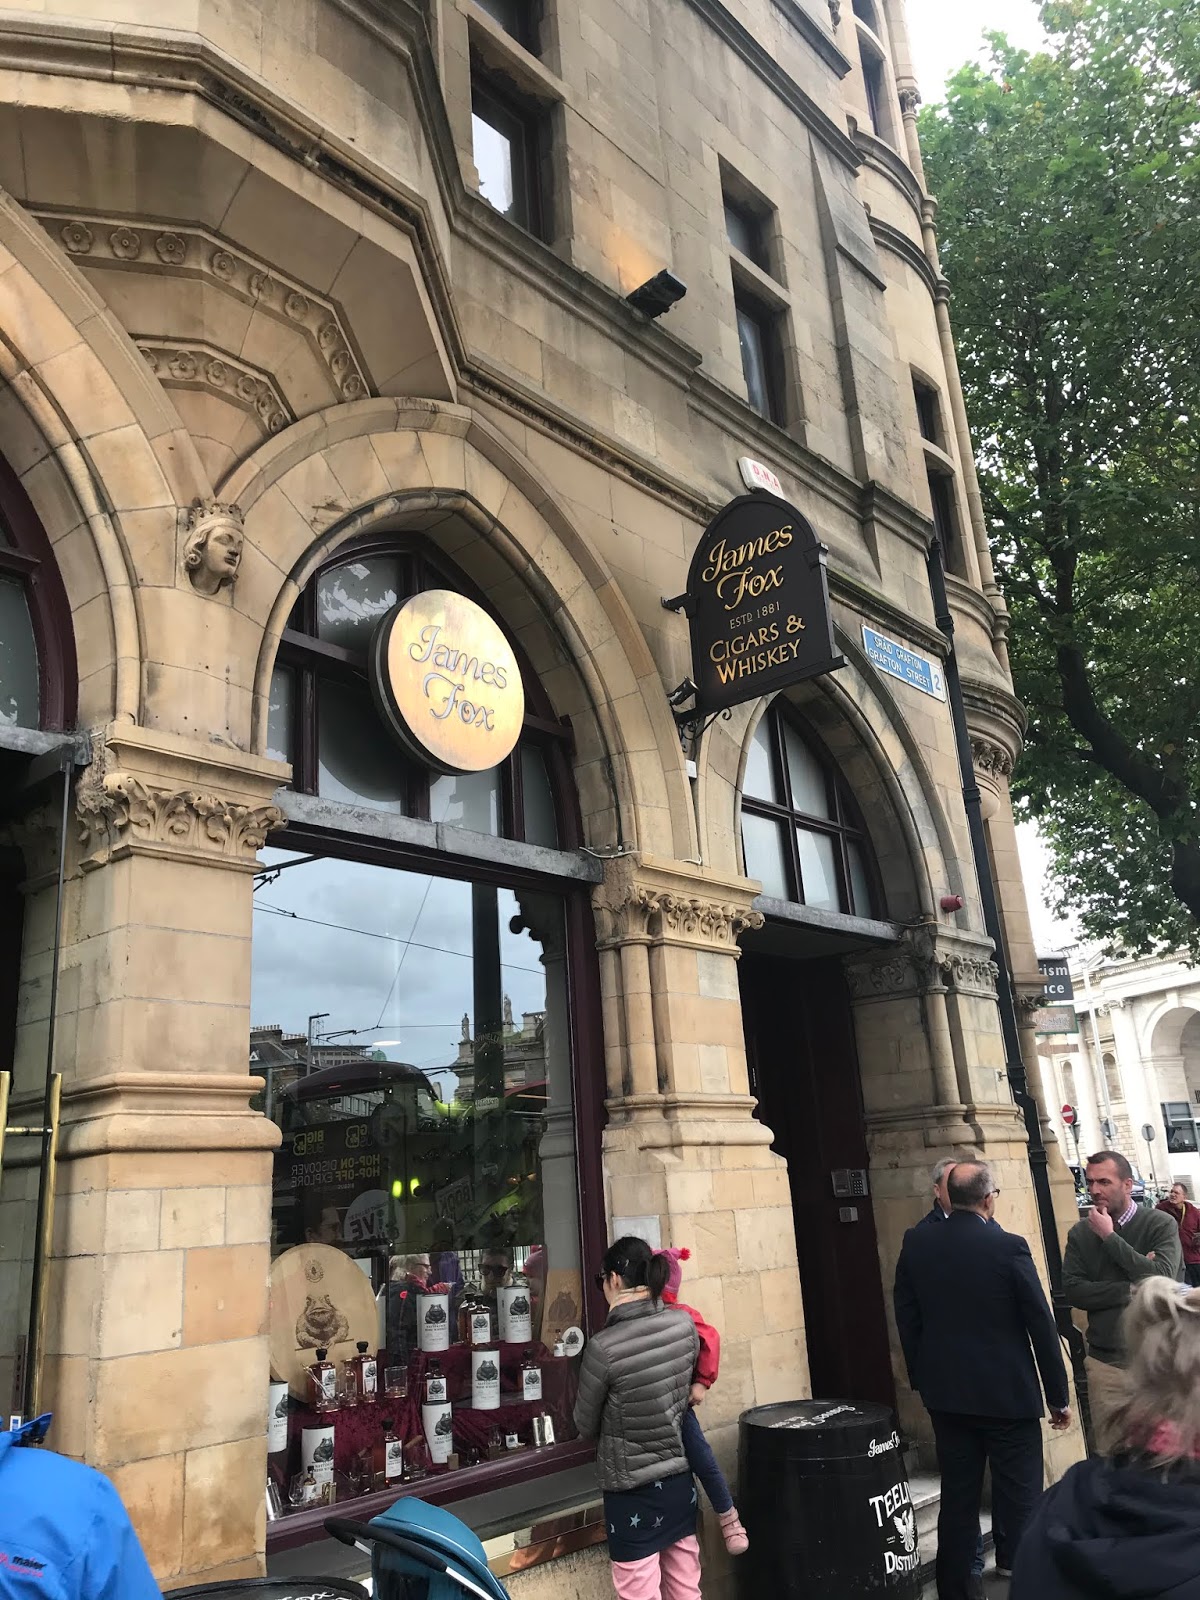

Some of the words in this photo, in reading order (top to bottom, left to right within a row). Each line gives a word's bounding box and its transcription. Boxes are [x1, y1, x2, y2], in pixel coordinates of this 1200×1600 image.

[702, 525, 793, 582] James
[717, 566, 784, 610] Fox
[709, 622, 779, 663] CIGARS
[786, 614, 806, 634] &
[729, 612, 753, 630] ESTD
[757, 601, 780, 619] 1881
[408, 625, 507, 690] James
[716, 638, 801, 685] WHISKEY
[868, 647, 903, 674] GRAFTON
[906, 667, 930, 688] STREET
[423, 672, 495, 732] Fox
[933, 674, 941, 691] 2
